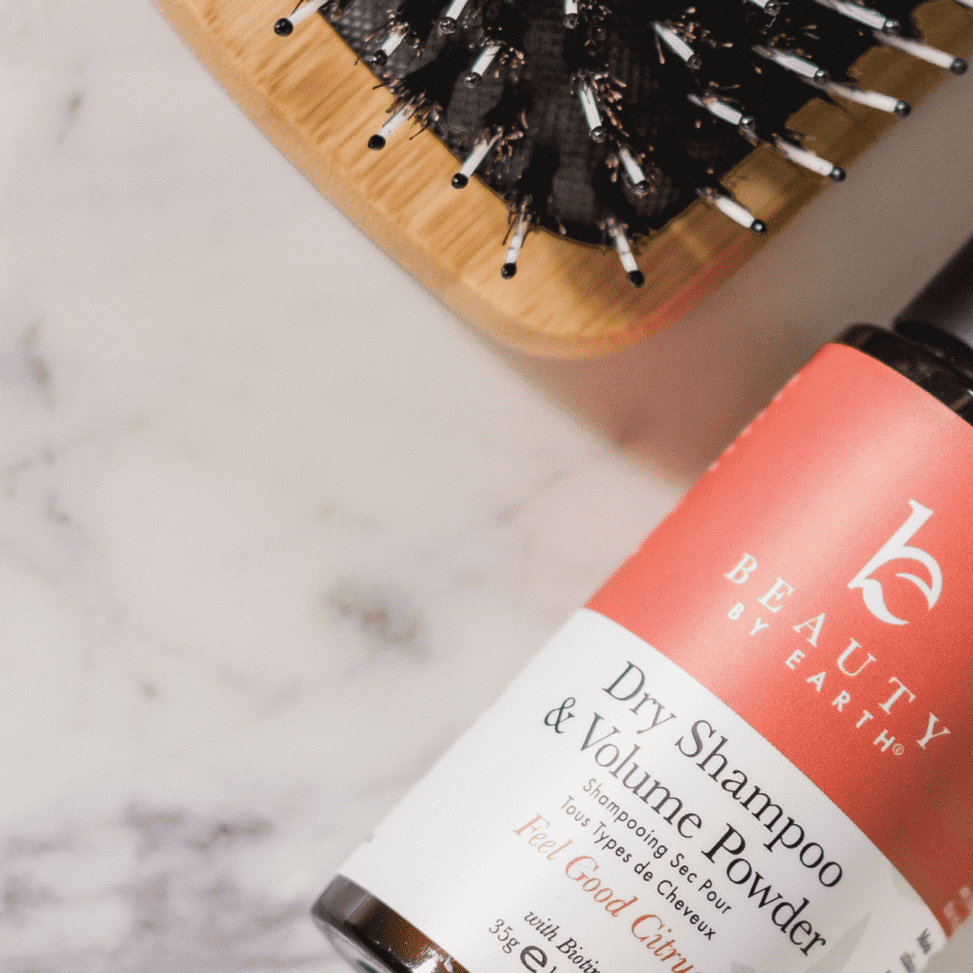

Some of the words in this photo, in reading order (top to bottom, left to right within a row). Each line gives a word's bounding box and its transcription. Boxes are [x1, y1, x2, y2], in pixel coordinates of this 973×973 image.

[724, 552, 950, 749] BEAUTY
[726, 601, 769, 636] BY
[543, 696, 575, 734] &
[580, 711, 703, 839] Volume
[701, 822, 826, 956] Powder
[582, 777, 669, 859] Shampooing
[670, 852, 698, 884] Sec
[698, 878, 732, 914] Pour
[602, 660, 676, 735] Dry
[674, 719, 843, 887] Shampoo
[488, 918, 521, 955] 35g
[512, 812, 574, 861] Feel
[565, 855, 639, 918] Good
[631, 913, 702, 973] Citru
[523, 911, 560, 942] with
[560, 794, 591, 828] Tous
[592, 820, 633, 864] Types
[633, 861, 654, 882] de
[656, 879, 717, 941] Cheveux
